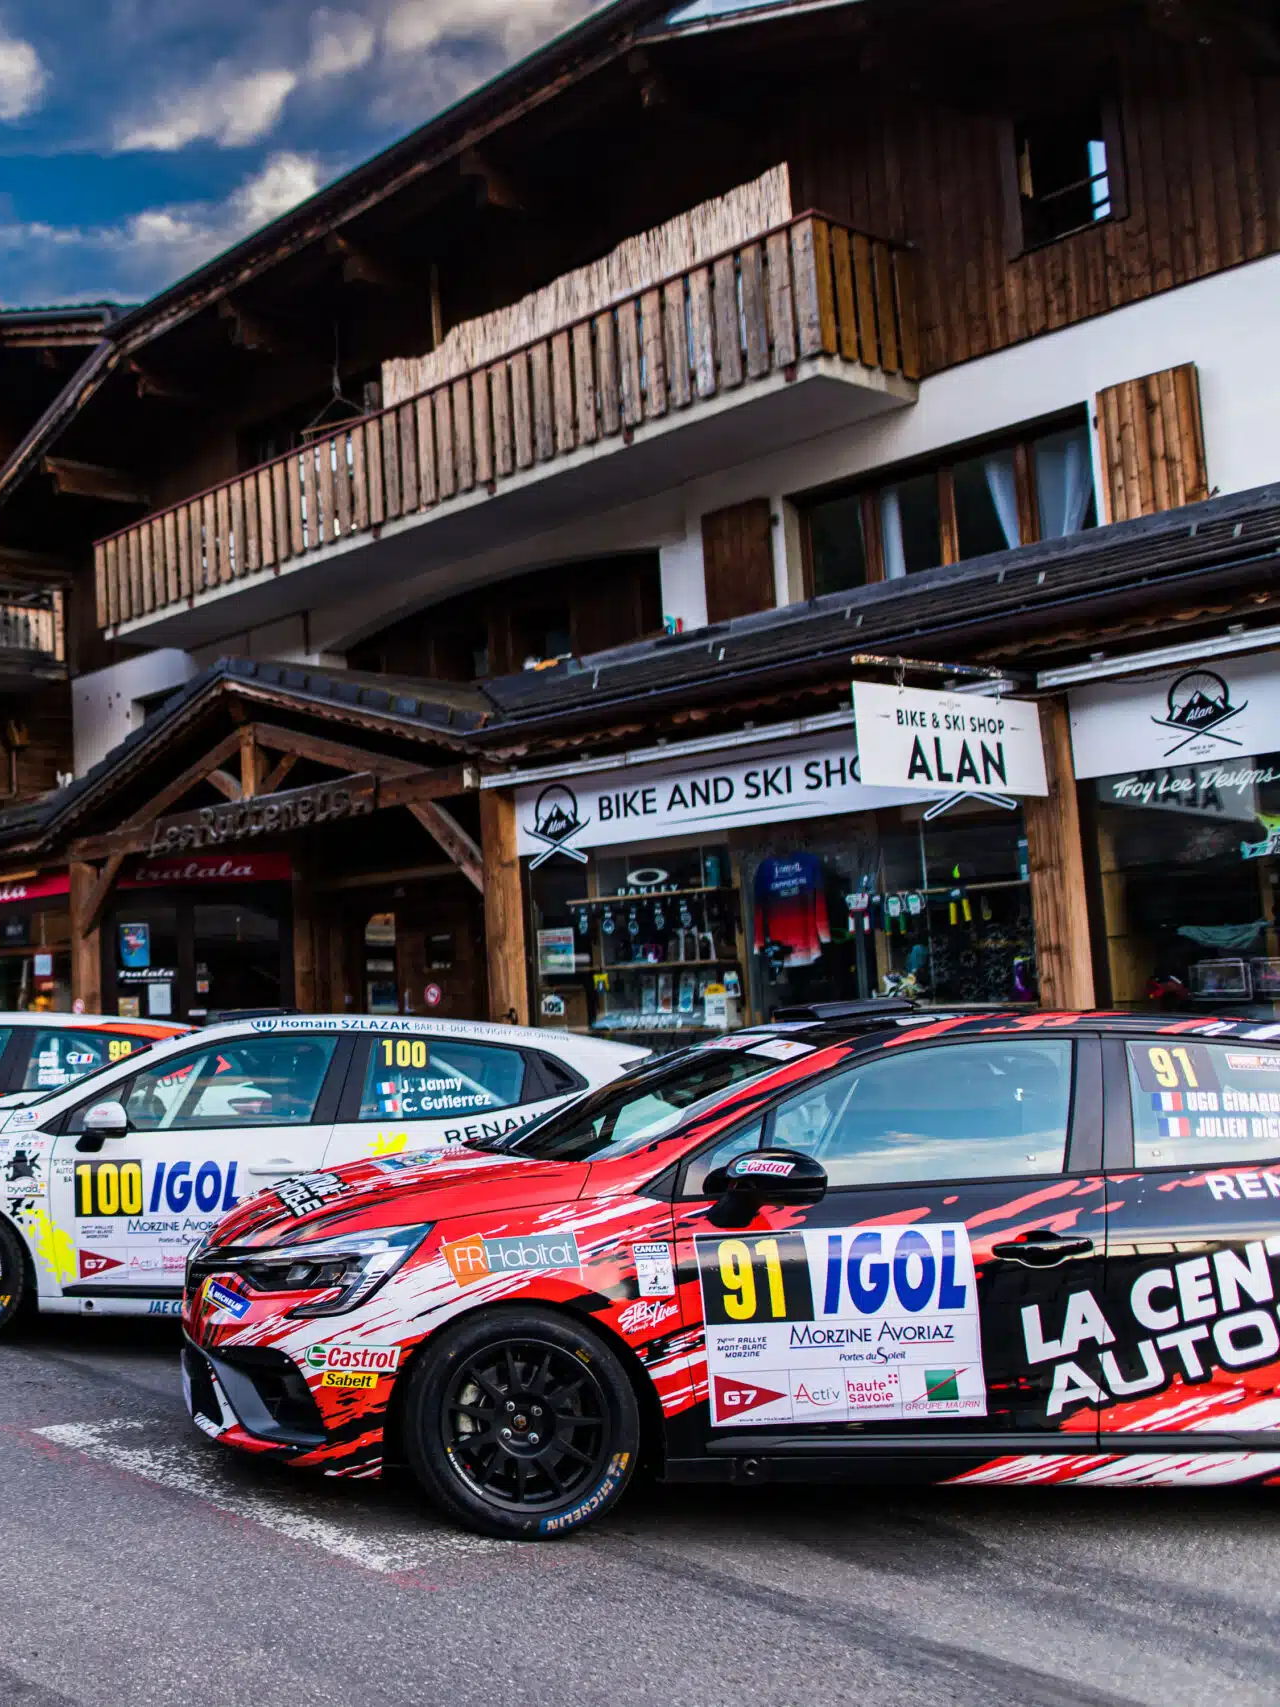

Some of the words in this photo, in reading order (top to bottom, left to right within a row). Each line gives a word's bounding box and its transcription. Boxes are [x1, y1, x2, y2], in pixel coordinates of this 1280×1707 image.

[896, 709, 927, 728] BIKE
[932, 715, 940, 729] &
[945, 714, 966, 732] SKI
[971, 717, 1005, 734] SHOP
[1186, 705, 1214, 722] Alan
[908, 734, 1007, 786] ALAN
[598, 787, 658, 822] BIKE
[667, 776, 735, 812] AND
[745, 766, 793, 799] SKI
[804, 755, 861, 790] SH
[1113, 776, 1156, 804] Troy
[1158, 774, 1195, 794] Lee
[1200, 766, 1280, 795] Designs
[135, 861, 255, 881] tralala
[617, 884, 679, 897] OAKLEY
[543, 1001, 562, 1013] 105
[341, 1019, 411, 1031] SZLAZAK
[108, 1040, 132, 1062] 99
[382, 1039, 426, 1068] 100
[1148, 1047, 1199, 1088] 91
[400, 1080, 414, 1093] J.
[417, 1077, 463, 1092] Janny
[402, 1099, 417, 1112] C.
[420, 1093, 492, 1112] Gutierrez
[1186, 1091, 1219, 1112] UGO
[444, 1112, 544, 1143] RENA
[1195, 1117, 1248, 1138] JULIEN
[747, 1160, 791, 1175] Castrol
[76, 1162, 142, 1216] 100
[149, 1160, 241, 1214] IGOL
[1206, 1172, 1280, 1200] REN
[127, 1218, 179, 1232] MORZINE
[182, 1217, 217, 1232] AVOR
[634, 1244, 668, 1254] CANAL+
[83, 1259, 108, 1269] G7
[717, 1238, 787, 1320] 91
[823, 1230, 967, 1315] IGOL
[148, 1301, 170, 1314] JAE
[213, 1290, 244, 1313] MICHELIN
[1021, 1289, 1116, 1364] LA
[1130, 1236, 1280, 1330] CEN
[737, 1336, 768, 1344] RALLYE
[789, 1324, 872, 1345] MORZINE
[877, 1321, 955, 1342] AVORIAZ
[716, 1343, 768, 1351] MONT-BLANC
[839, 1351, 865, 1361] Portes
[865, 1351, 877, 1360] du
[875, 1347, 907, 1364] Soleil
[326, 1347, 396, 1368] Castrol
[1046, 1309, 1280, 1416] AUTO
[325, 1373, 372, 1388] Sabelt
[847, 1379, 887, 1392] haute
[723, 1389, 758, 1405] G7
[849, 1391, 895, 1403] savoie
[904, 1401, 943, 1412] GROUPE
[944, 1399, 981, 1411] MAURIN
[546, 1478, 615, 1531] MICHELIN
